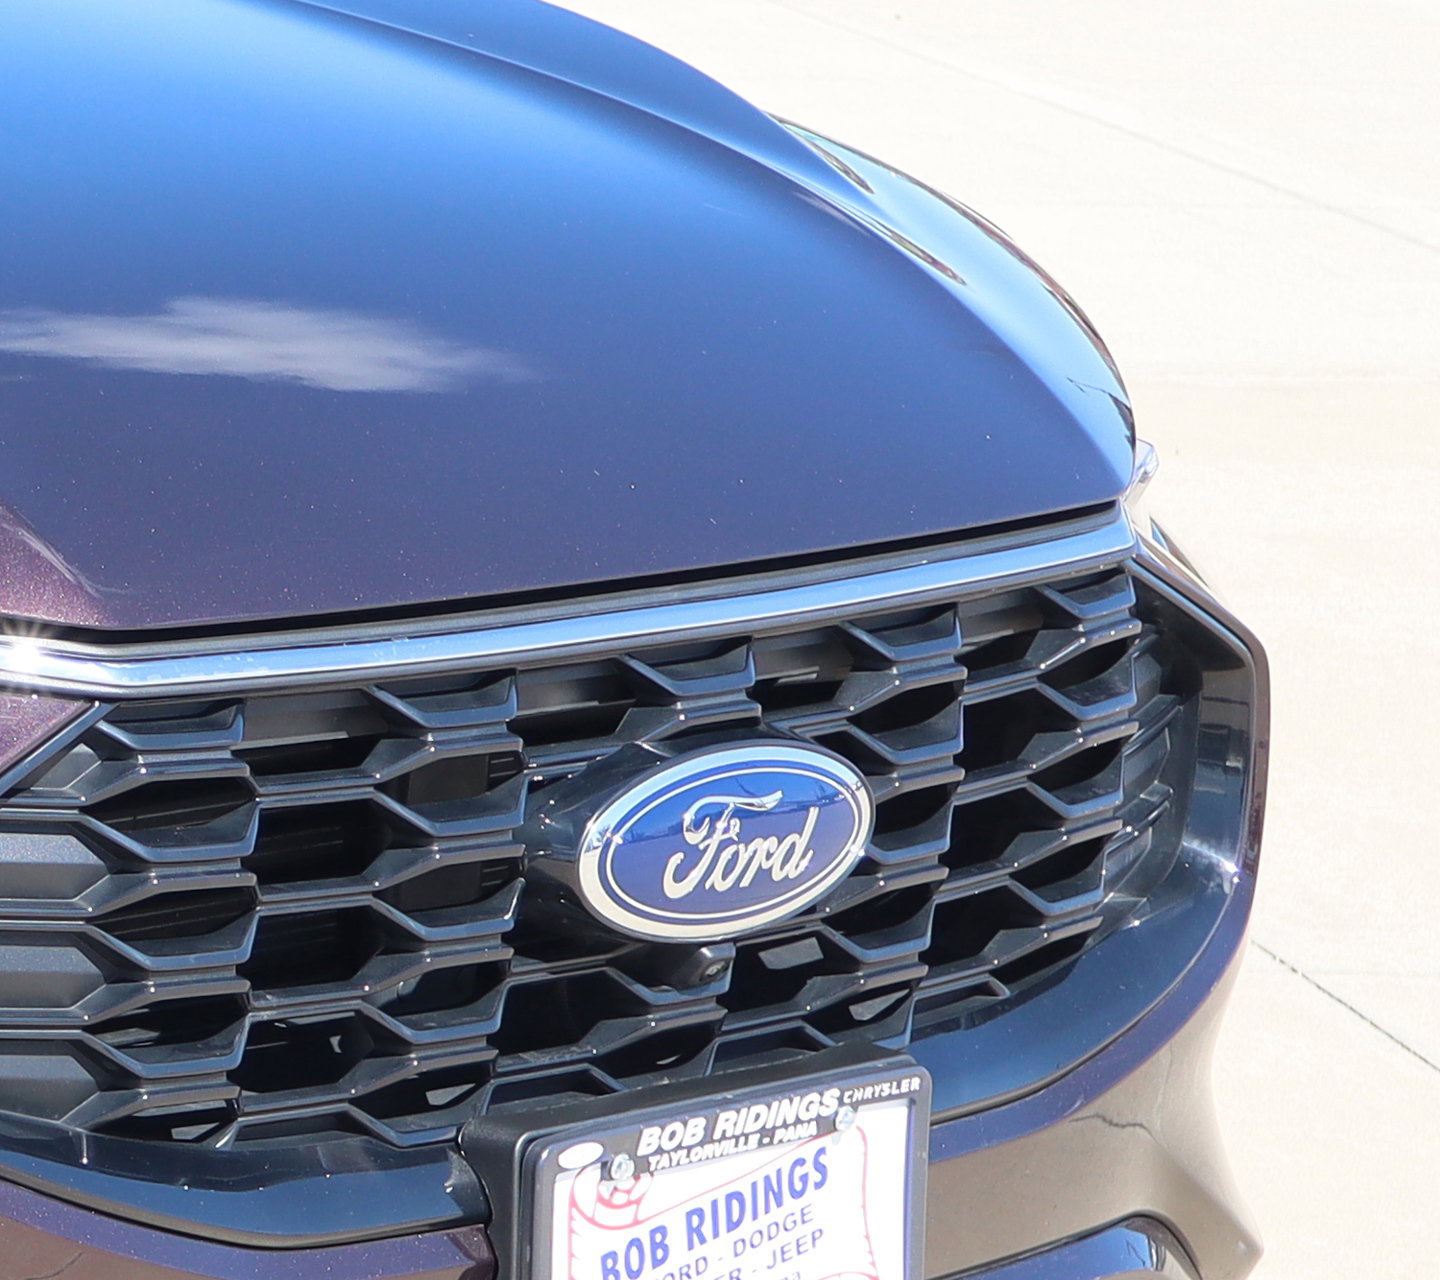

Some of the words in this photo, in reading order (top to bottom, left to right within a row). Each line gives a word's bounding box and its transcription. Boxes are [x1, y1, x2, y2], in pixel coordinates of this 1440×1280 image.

[663, 790, 820, 899] Ford
[637, 1116, 707, 1157] BOB
[713, 1087, 842, 1140] RIDINGS
[843, 1076, 922, 1105] CHRYSLER
[647, 1135, 759, 1172] TAYLORVILLE
[774, 1120, 818, 1144] PANA
[685, 1146, 829, 1251] RIDINGS
[733, 1203, 814, 1258] DODGE
[766, 1228, 824, 1270] JEEP
